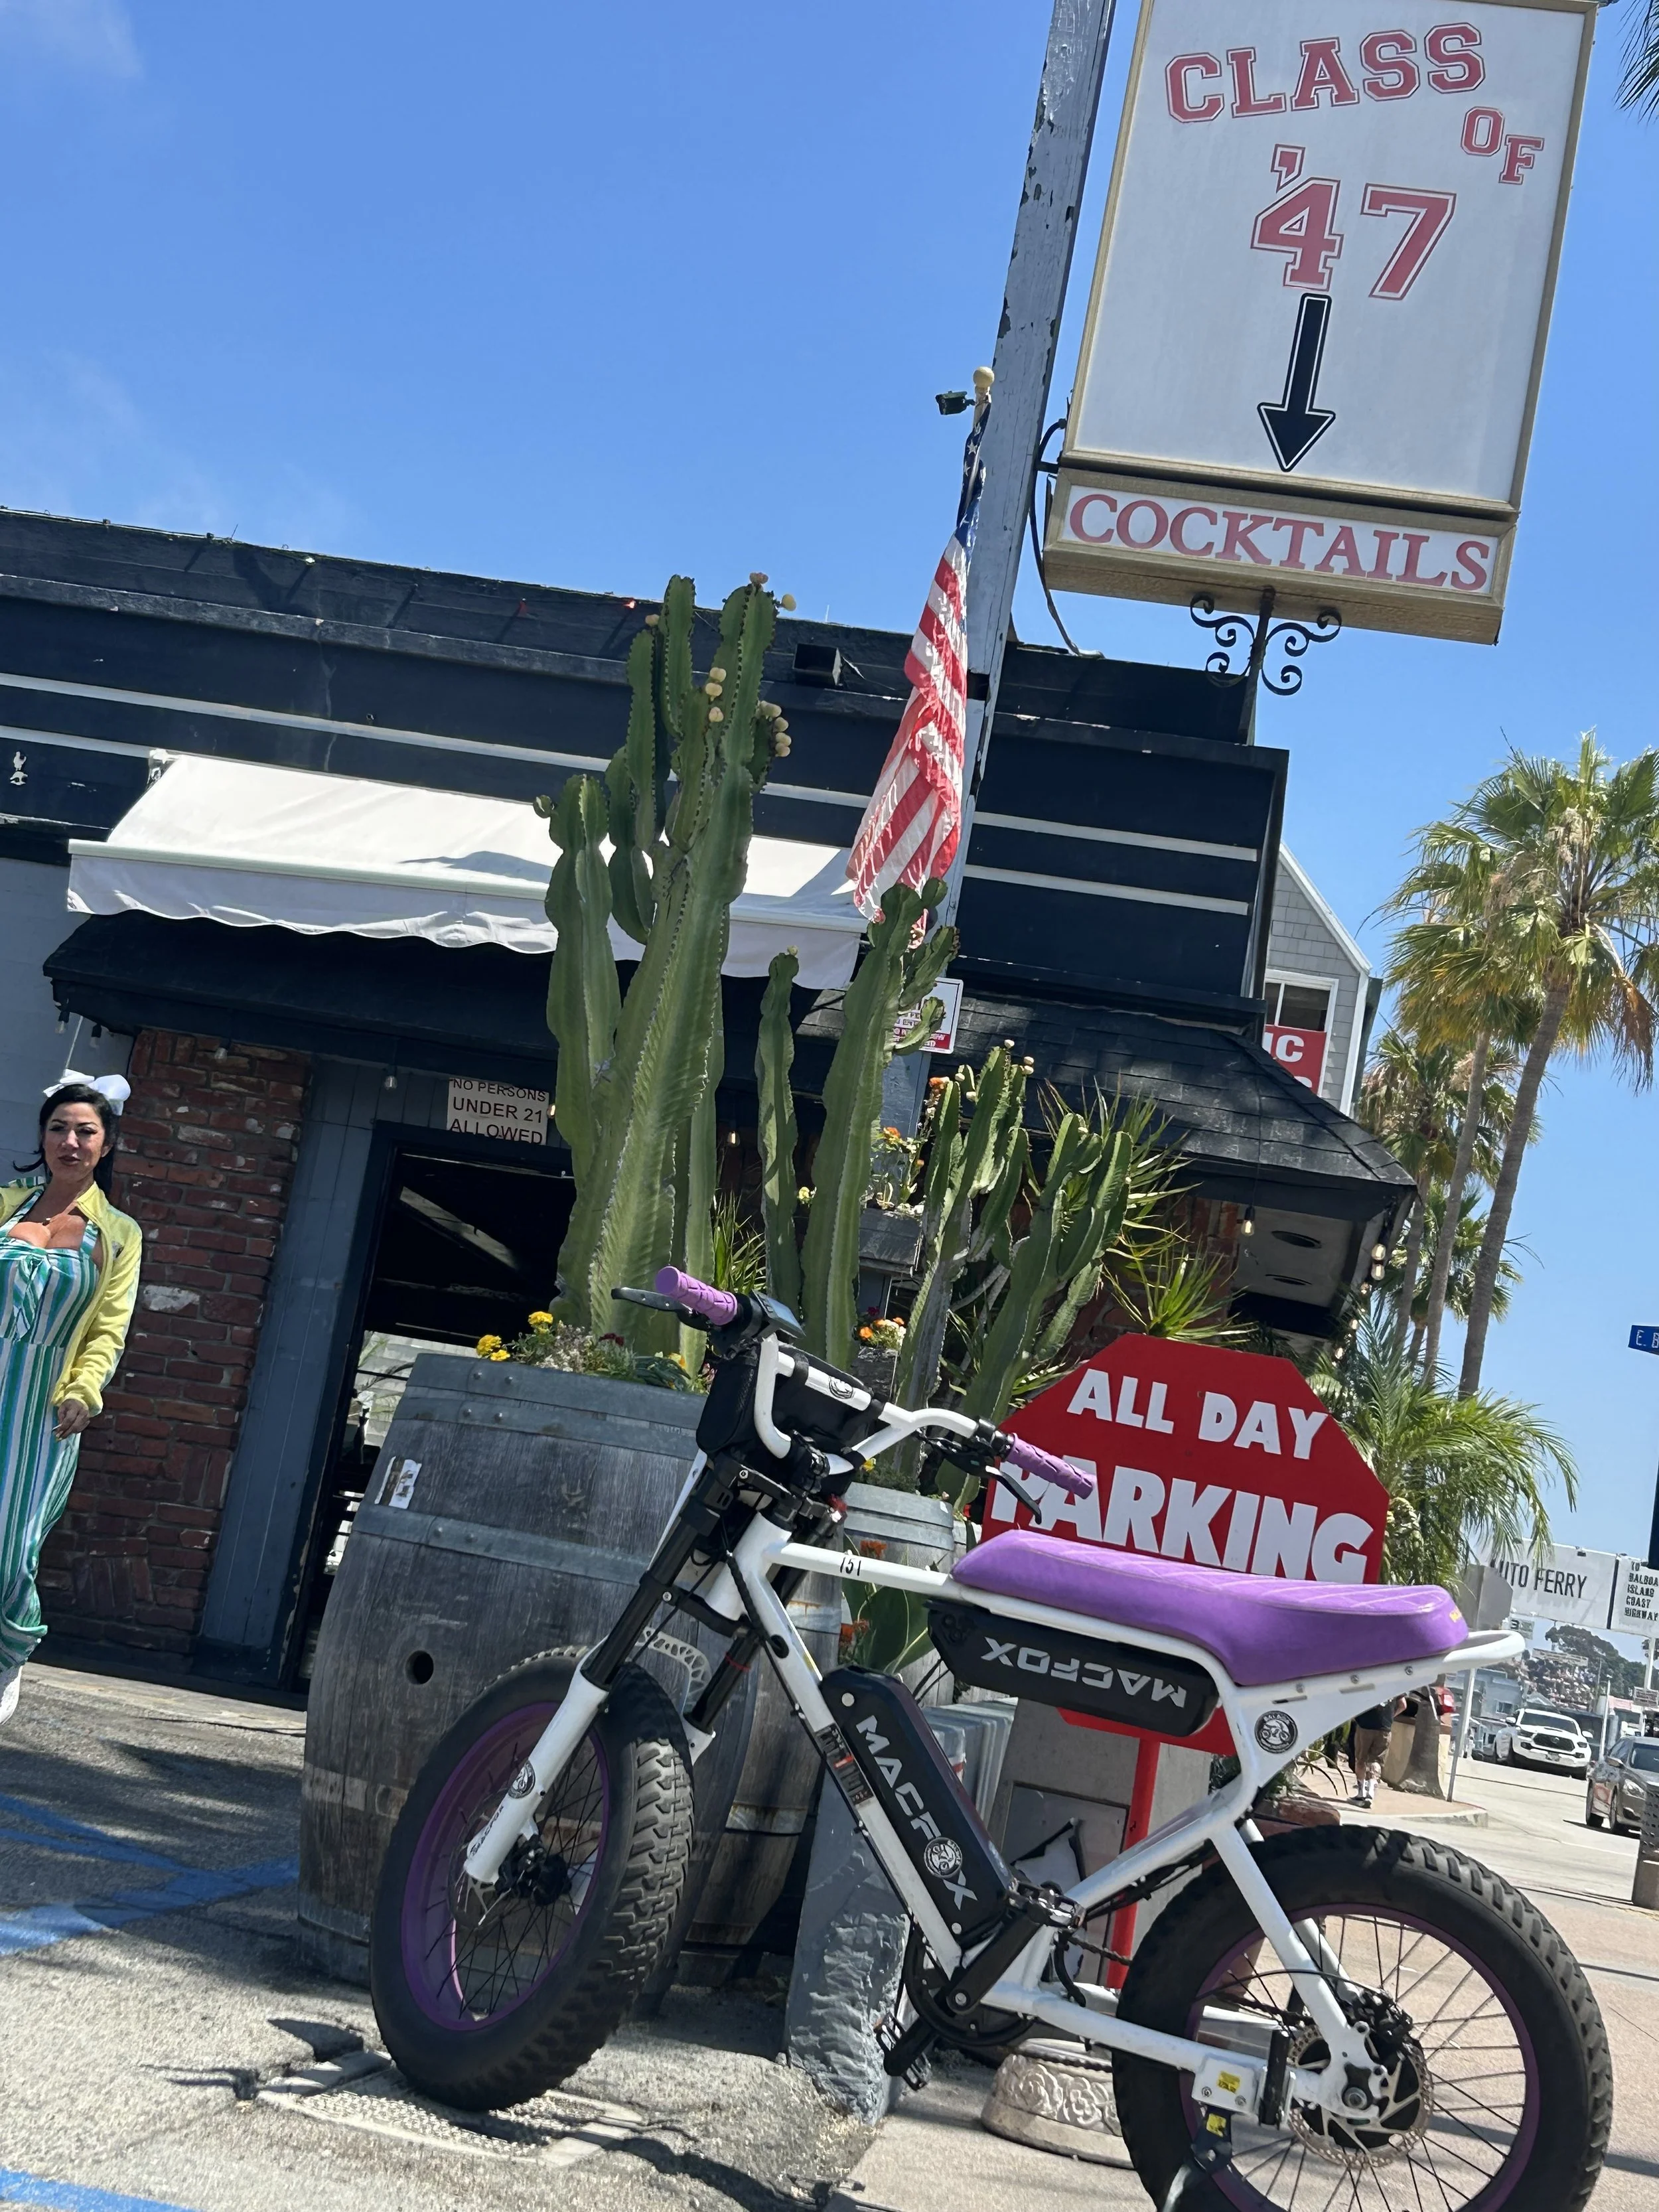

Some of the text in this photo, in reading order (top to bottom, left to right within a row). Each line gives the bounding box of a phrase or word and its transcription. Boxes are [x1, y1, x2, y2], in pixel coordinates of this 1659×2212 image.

[1165, 22, 1486, 123] CLASS
[1461, 106, 1545, 186] OF
[1069, 494, 1489, 591] COCKTAILS
[453, 1078, 546, 1102] NO PERSONS
[453, 1096, 541, 1123] UNDER 21
[450, 1118, 543, 1145] ALLOWED
[1636, 1329, 1646, 1346] E
[1066, 1368, 1329, 1460] ALL DAY
[991, 1454, 1374, 1584] PARKING
[840, 1557, 861, 1576] 151
[1628, 1572, 1658, 1587] BALBOA
[1534, 1568, 1587, 1599] FERRY
[1626, 1584, 1655, 1597] ISLAND
[1624, 1607, 1658, 1621] HIGHWAY
[1626, 1595, 1651, 1609] COAST
[981, 1636, 1187, 1708] MACFOX
